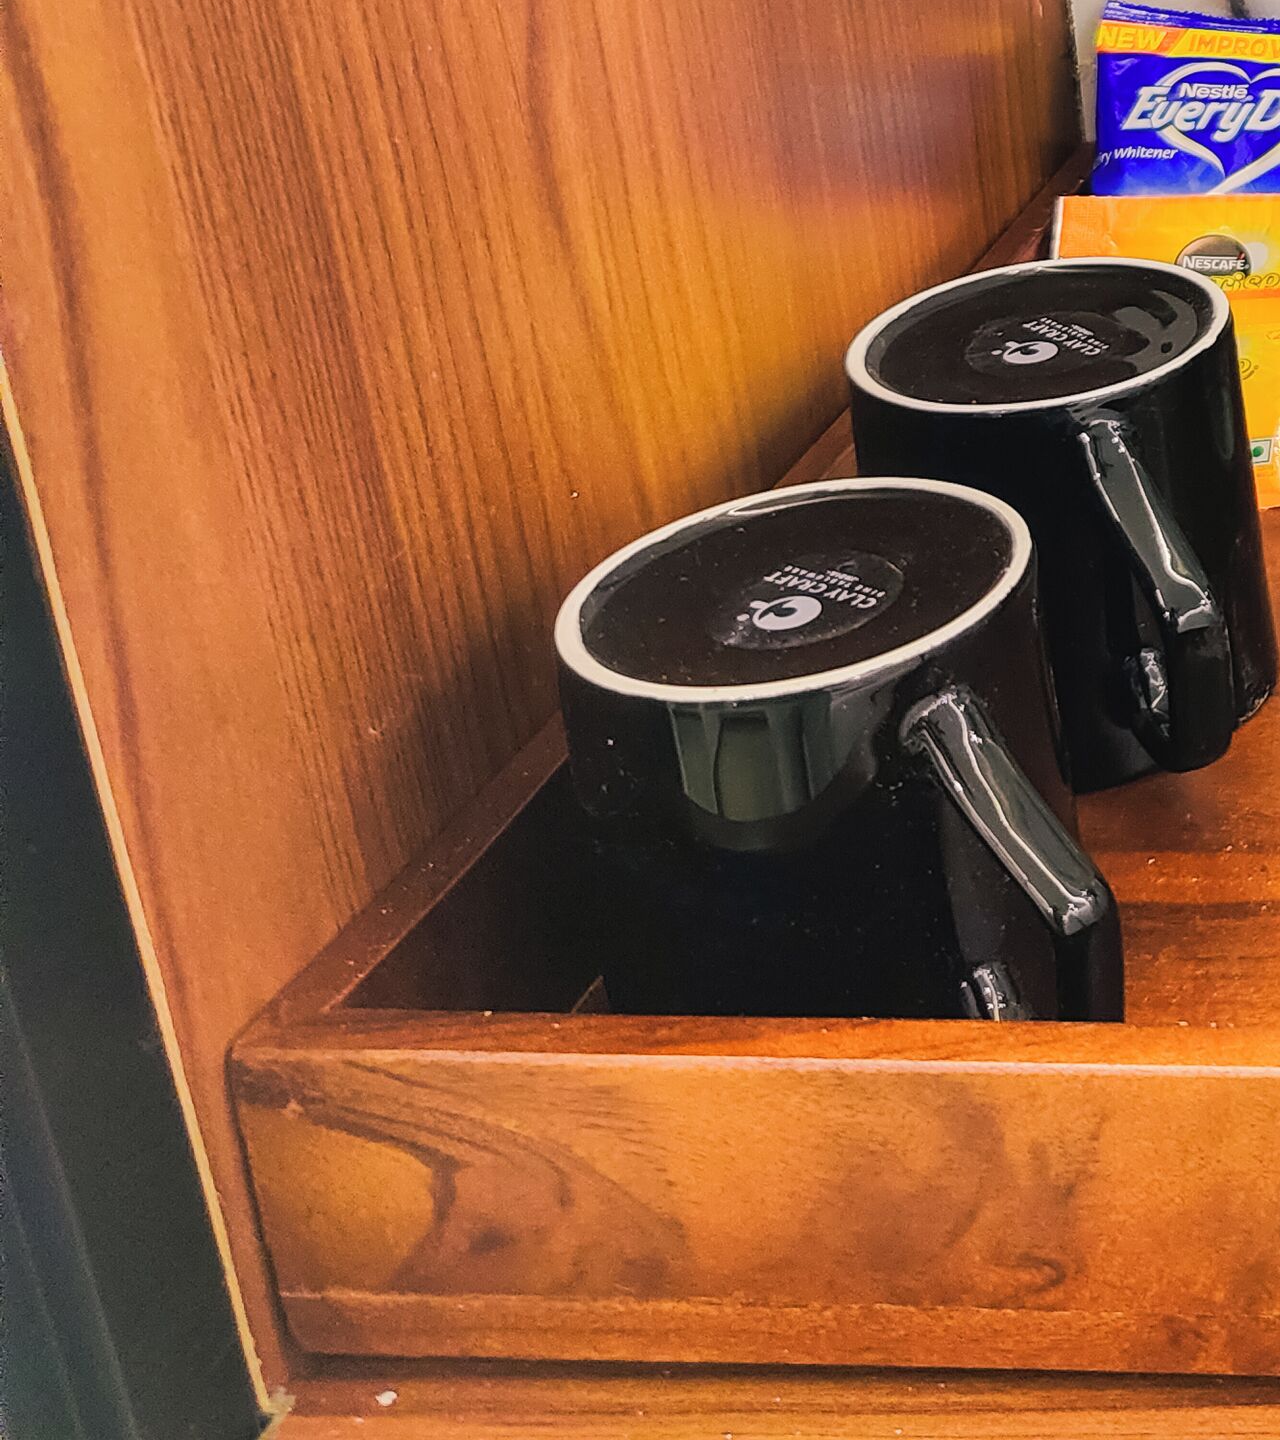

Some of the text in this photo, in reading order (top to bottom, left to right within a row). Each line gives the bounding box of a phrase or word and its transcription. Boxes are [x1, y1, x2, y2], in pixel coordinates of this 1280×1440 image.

[1097, 26, 1167, 51] NEW
[1114, 146, 1178, 160] Whitener
[1022, 320, 1068, 341] CRAFT
[1063, 338, 1102, 356] CLAY
[763, 571, 877, 609] CLAY CRAFT
